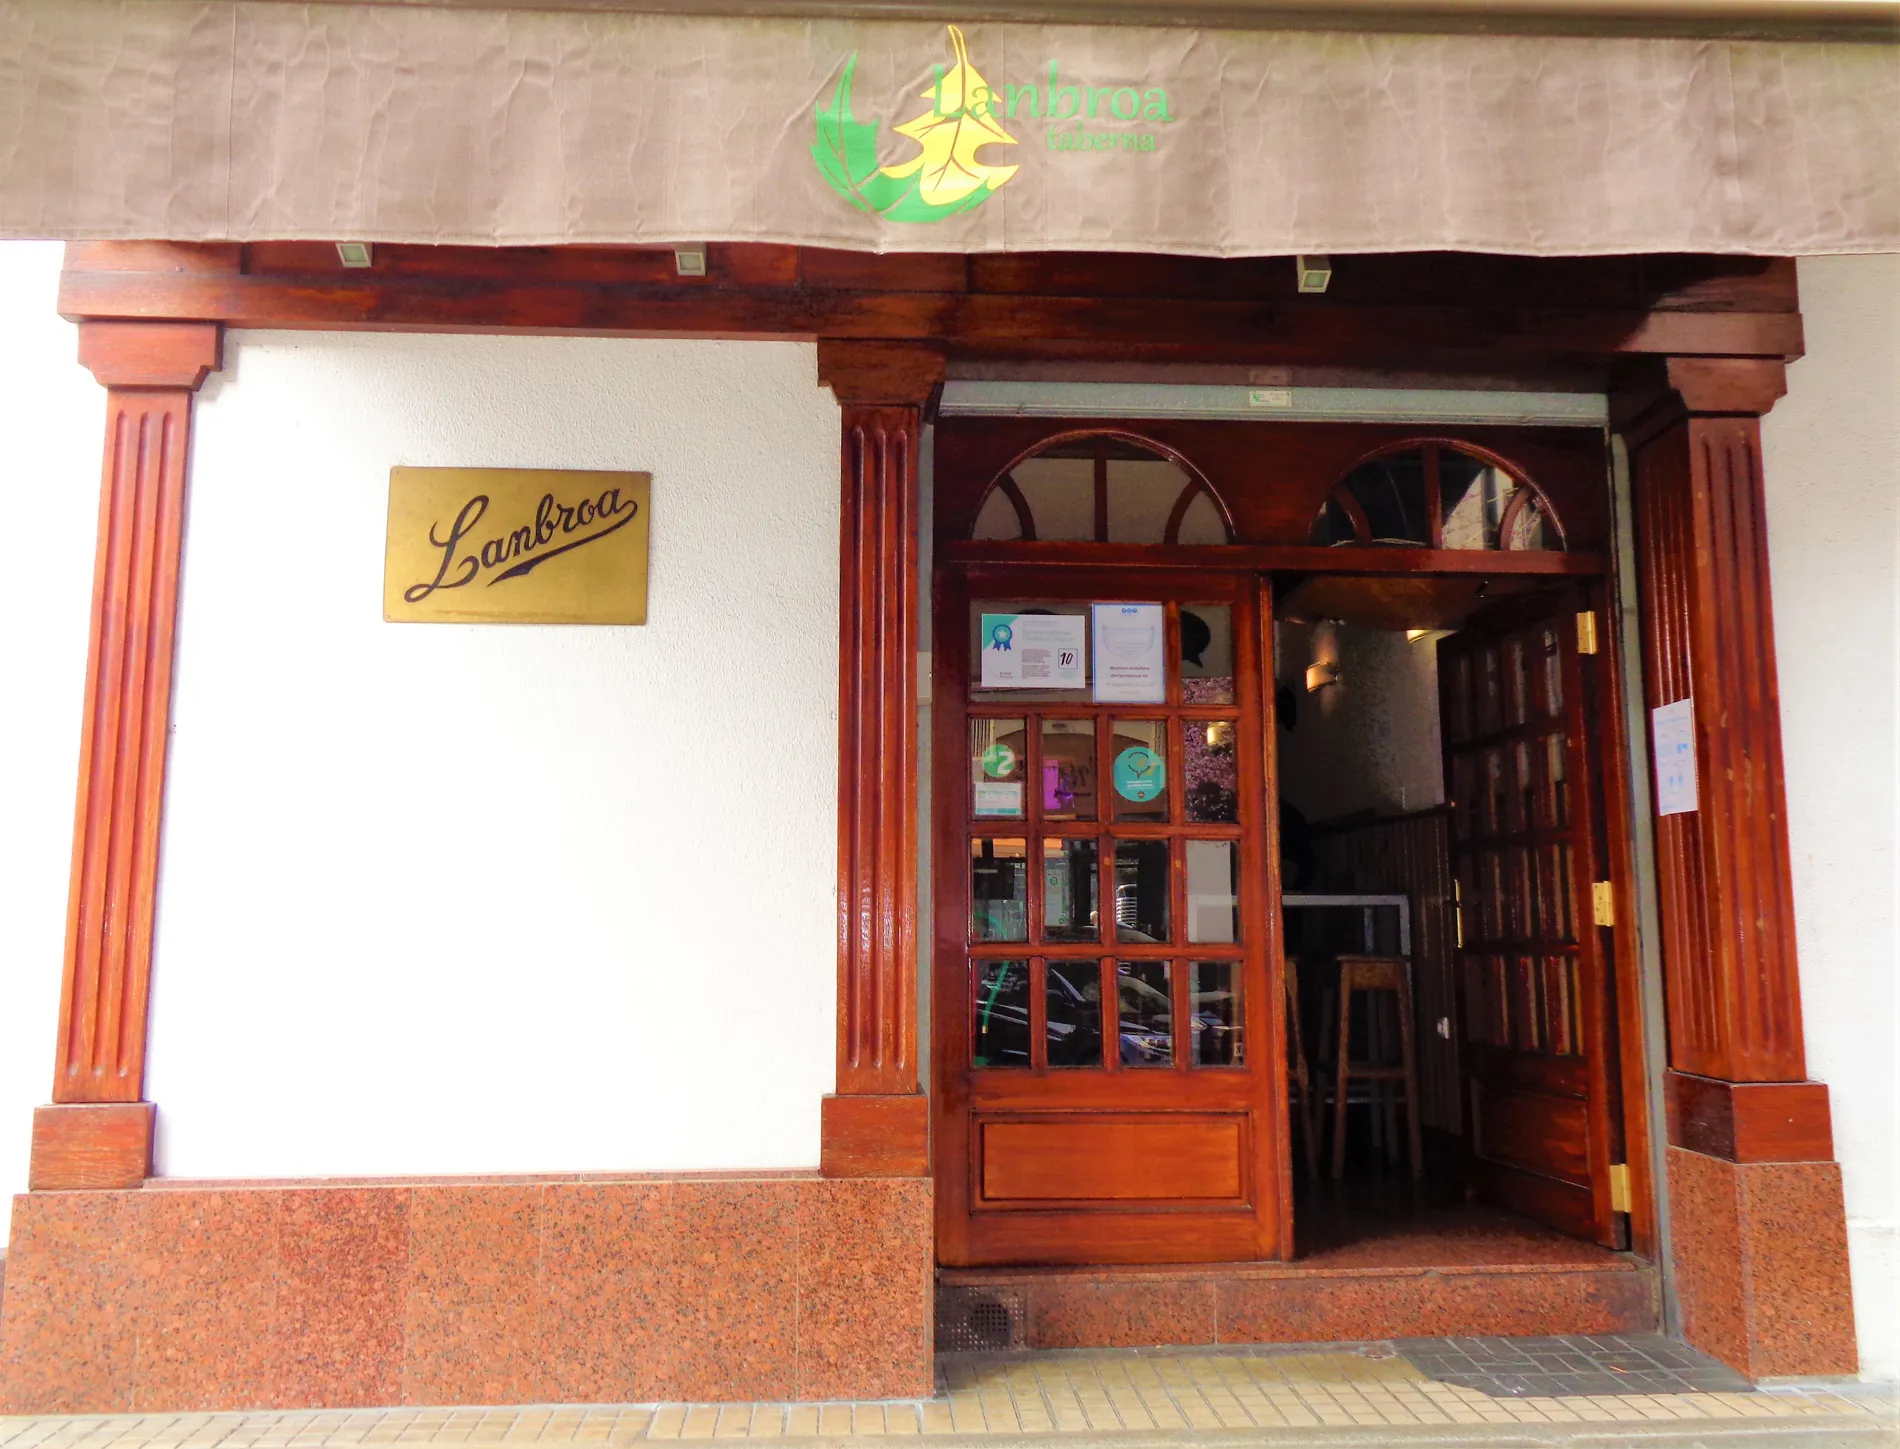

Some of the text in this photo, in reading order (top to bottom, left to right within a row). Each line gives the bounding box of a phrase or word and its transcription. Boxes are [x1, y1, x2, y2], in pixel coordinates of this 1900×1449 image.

[932, 60, 1173, 121] Lanbroa
[1047, 121, 1157, 151] taberna
[403, 487, 638, 603] Lanbroa
[1060, 652, 1074, 666] 10
